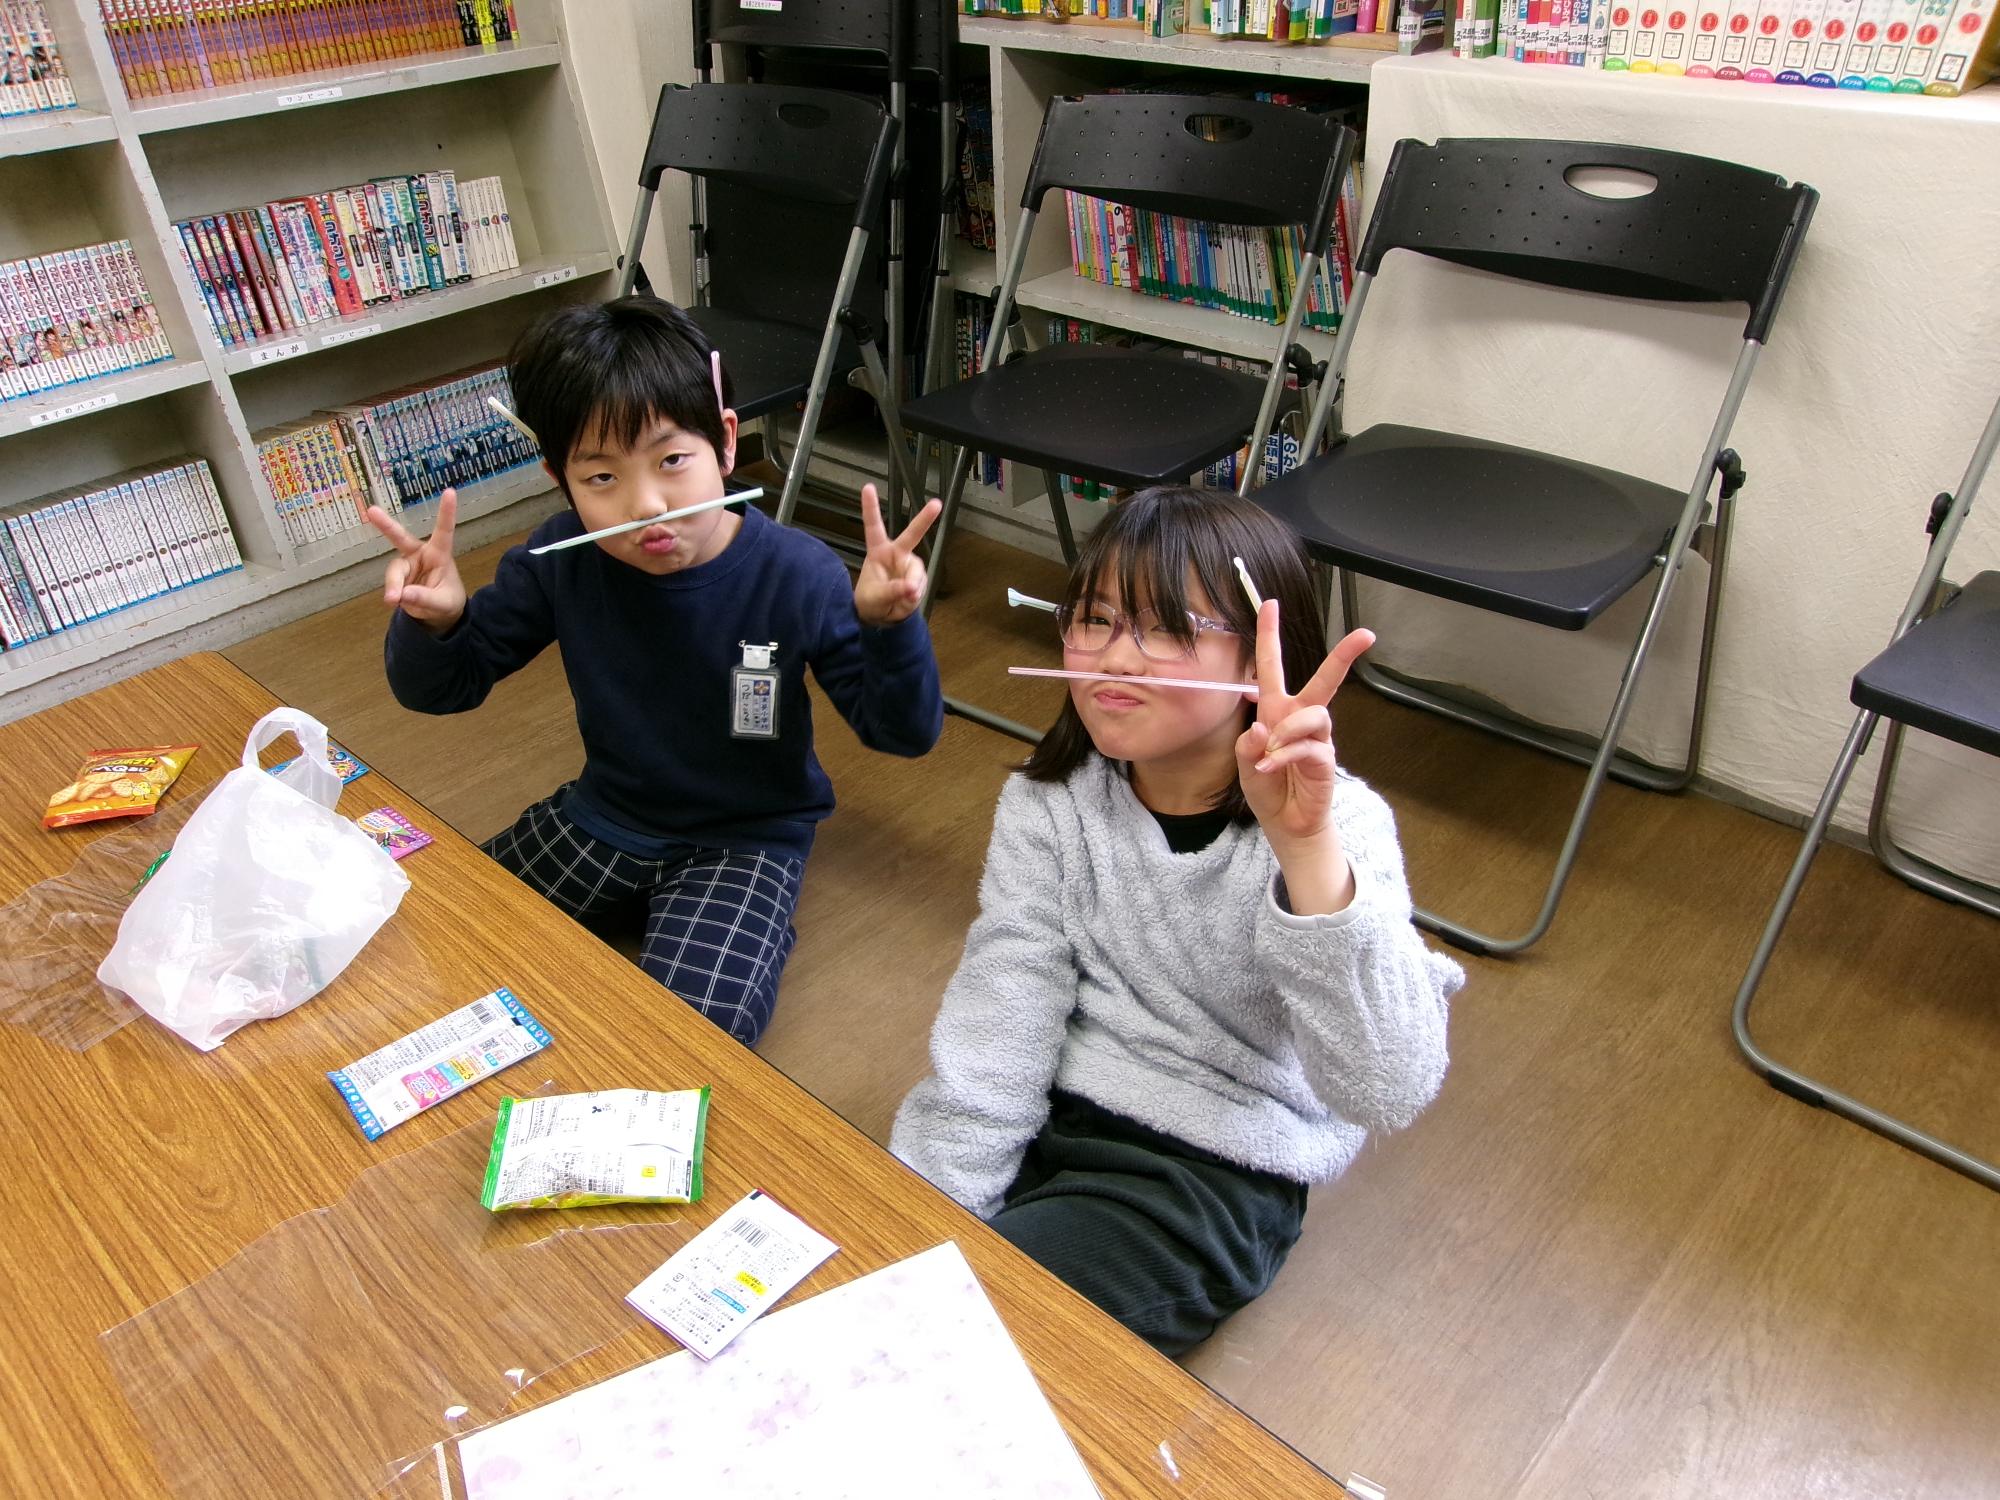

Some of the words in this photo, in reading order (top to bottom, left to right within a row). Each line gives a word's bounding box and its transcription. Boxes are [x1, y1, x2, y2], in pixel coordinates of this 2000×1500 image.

[286, 90, 335, 104] ワンピース
[71, 262, 83, 277] ONE
[79, 278, 94, 304] PIECE
[82, 260, 95, 275] ONE
[89, 276, 105, 302] PIECE
[95, 257, 107, 273] ONE
[102, 273, 117, 299] PIECE
[106, 255, 119, 271] ONE
[116, 253, 128, 268] ONE
[122, 269, 137, 294] PIECE
[127, 250, 139, 265] ONE
[133, 266, 148, 291] PIECE
[541, 270, 572, 285] まんが
[12, 275, 24, 291] ONE
[19, 291, 34, 318] PIECE
[23, 272, 36, 289] ONE
[30, 289, 47, 316] PIECE
[36, 269, 48, 286] ONE
[43, 286, 60, 312] PIECE
[49, 267, 61, 282] ONE
[56, 283, 71, 309] PIECE
[60, 264, 72, 280] ONE
[67, 281, 83, 307] PIECE
[112, 271, 128, 297] PIECE
[6, 294, 22, 321] PIECE
[260, 345, 300, 361] まんが
[328, 328, 376, 343] ワンピース
[40, 397, 108, 422] 黒子のバスケ
